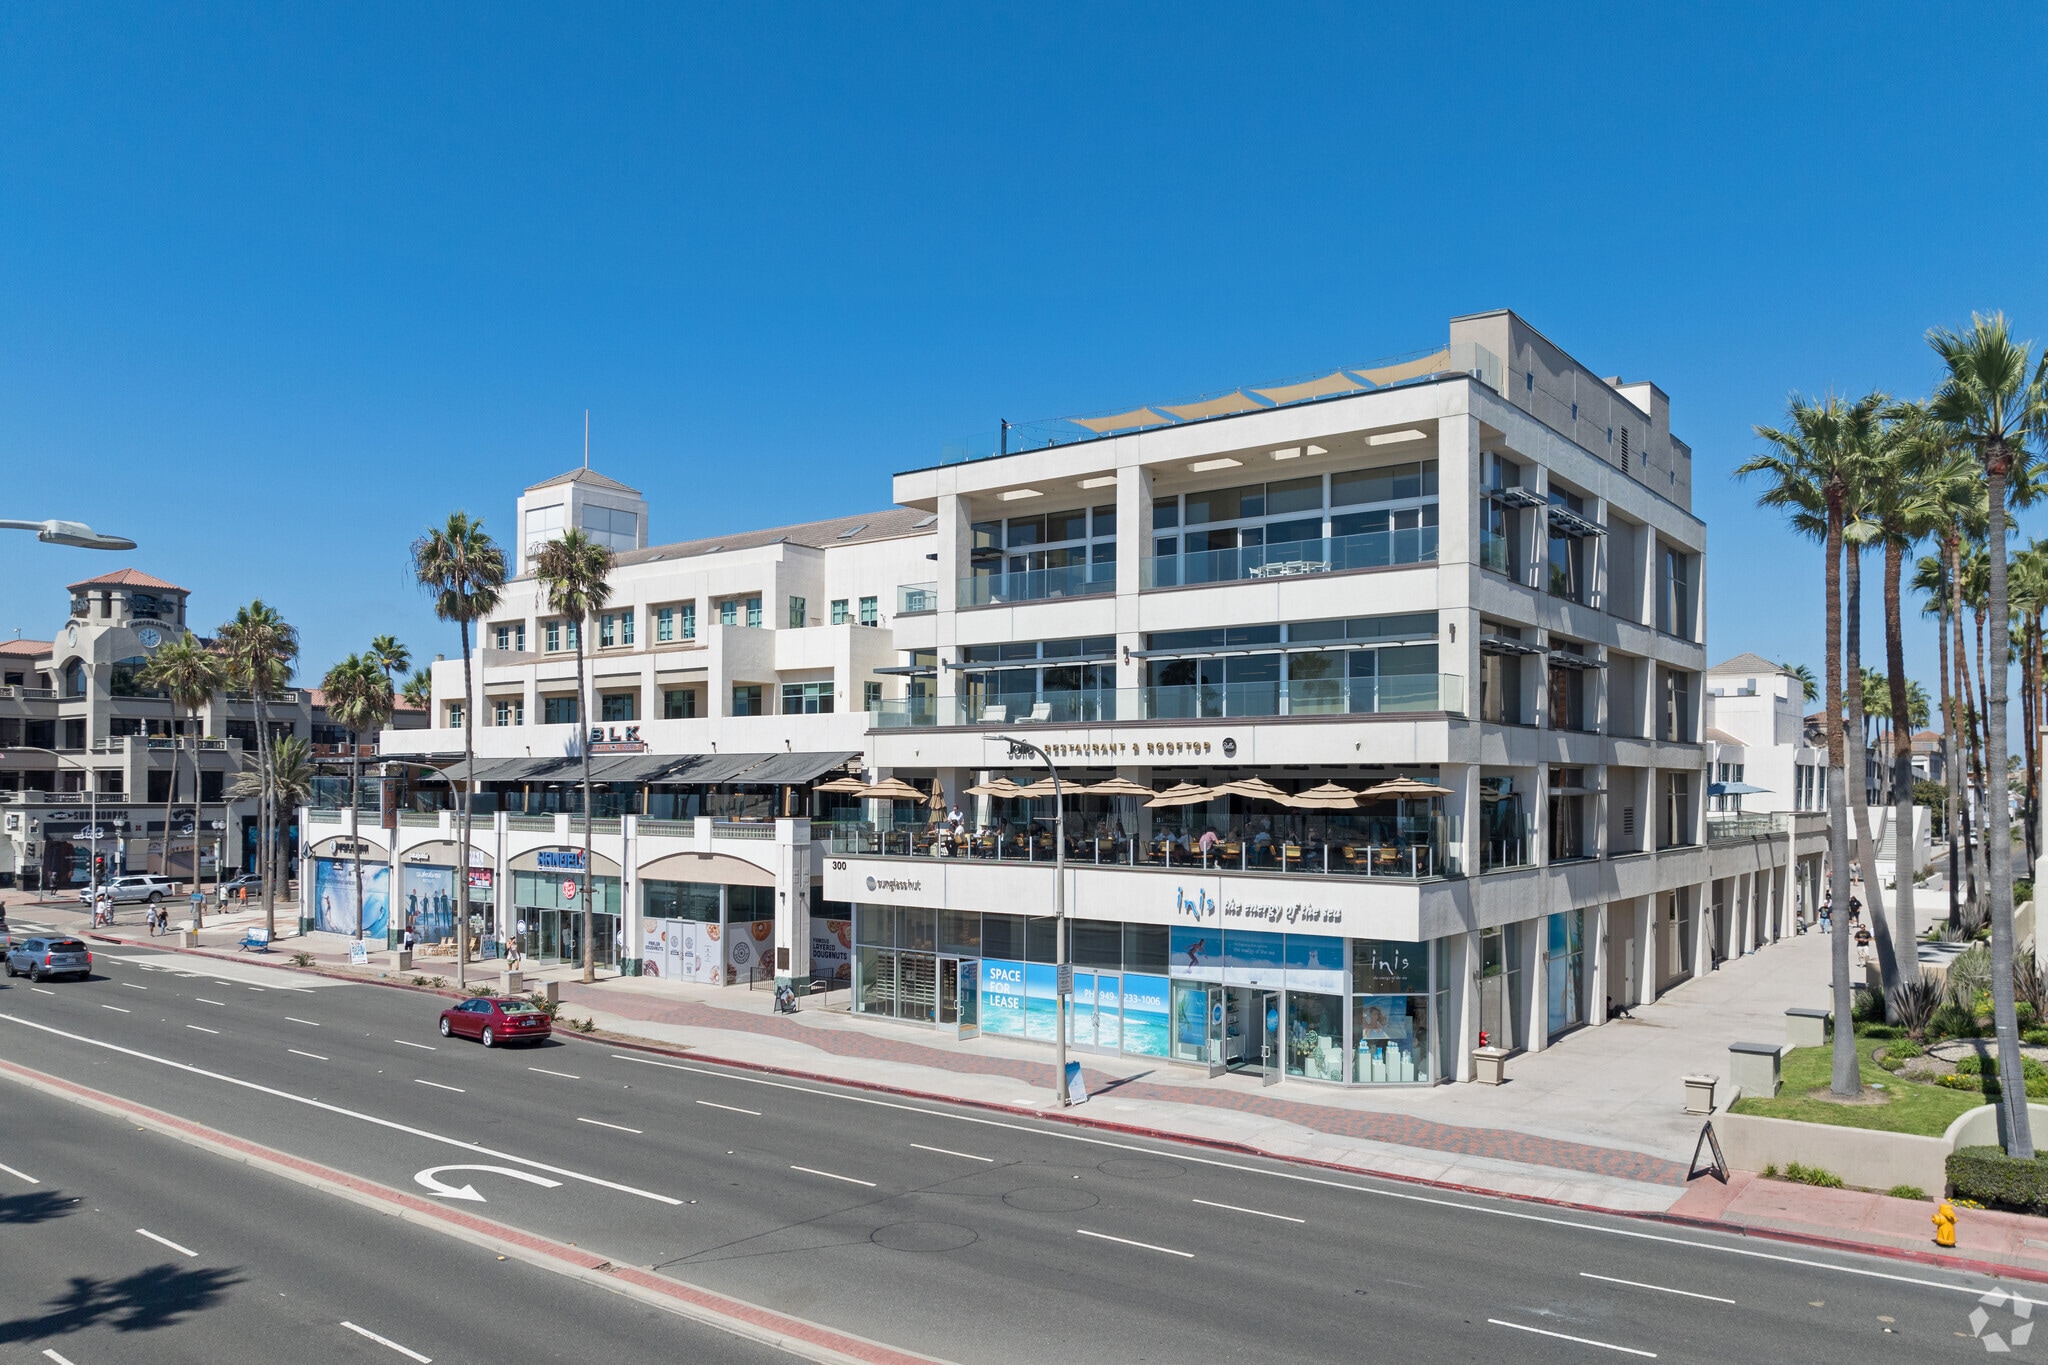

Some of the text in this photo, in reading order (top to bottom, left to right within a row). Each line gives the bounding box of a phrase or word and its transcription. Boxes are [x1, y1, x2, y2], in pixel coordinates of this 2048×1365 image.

[590, 725, 641, 742] BLK
[1044, 742, 1125, 755] RESTAURANT
[1147, 741, 1211, 754] ROOFTOP
[832, 861, 847, 871] 300
[1177, 886, 1216, 921] inis
[813, 943, 835, 951] LAYERED
[1371, 949, 1409, 975] inis
[990, 968, 1021, 982] SPACE
[990, 981, 1010, 994] FOR
[990, 994, 1019, 1009] LEASE
